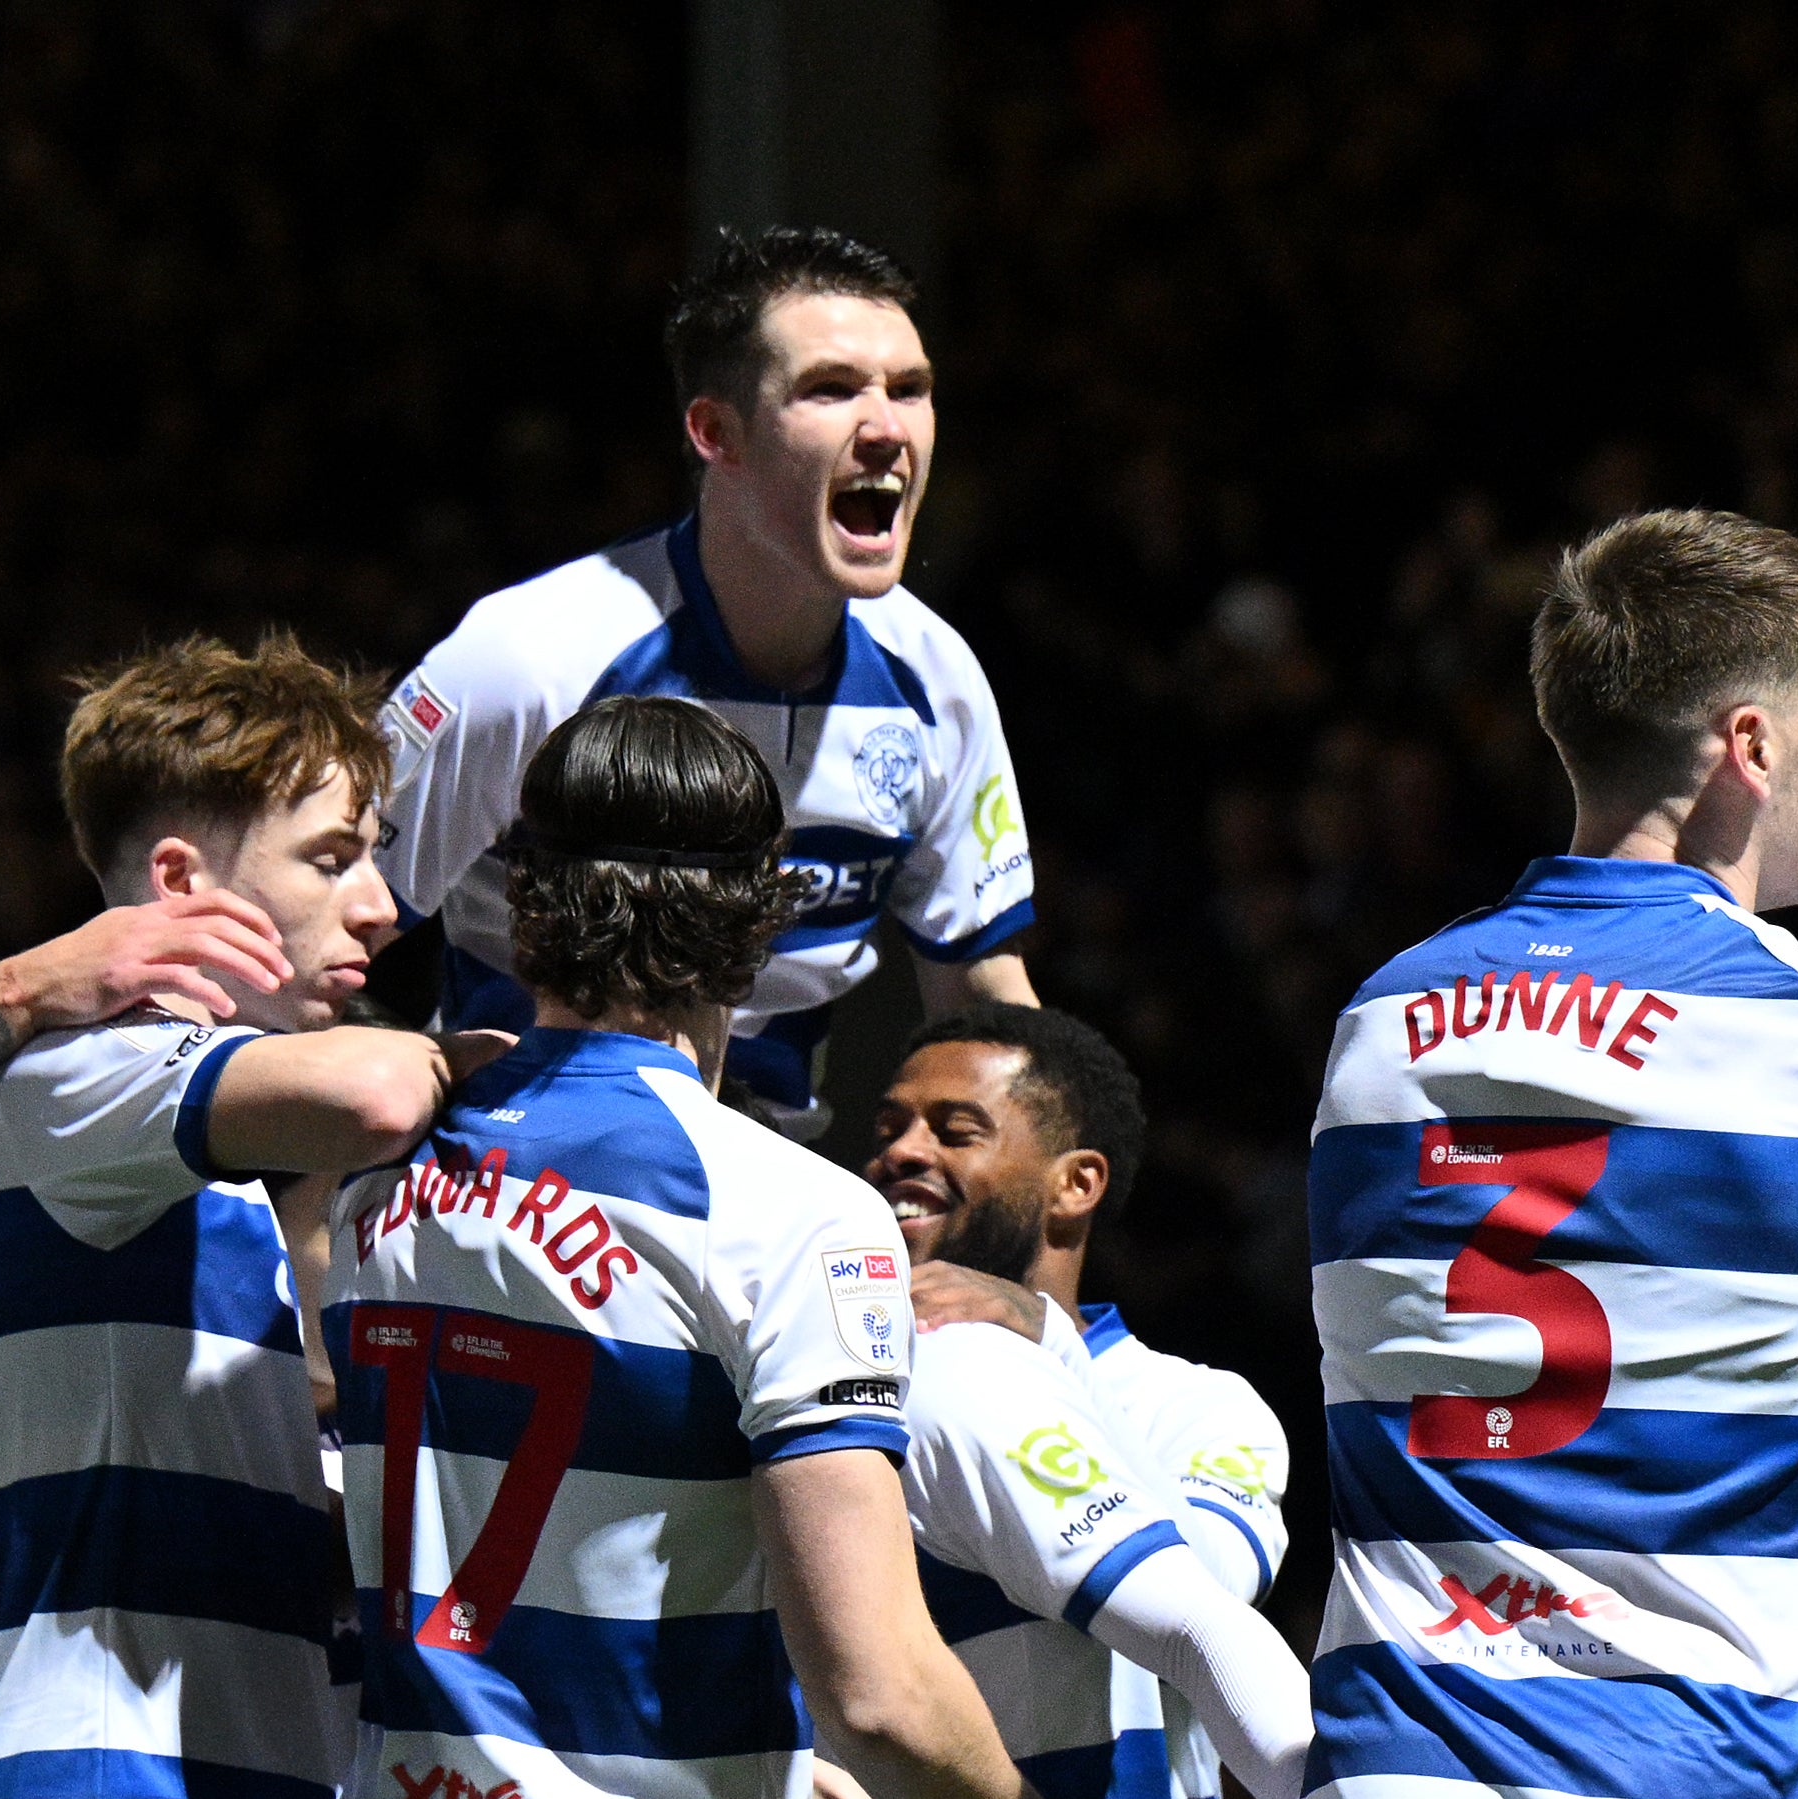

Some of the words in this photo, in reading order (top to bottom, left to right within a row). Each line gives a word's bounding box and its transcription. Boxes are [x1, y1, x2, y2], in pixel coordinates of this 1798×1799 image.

[1526, 943, 1574, 957] 1882
[1405, 970, 1678, 1071] DUNNE
[1447, 1154, 1503, 1164] COMMUNITY
[831, 1260, 862, 1279] sky
[867, 1257, 895, 1275] bet
[1406, 1124, 1612, 1459] 3
[465, 1345, 511, 1361] COMMUNITY
[871, 1344, 894, 1359] EFL
[1487, 1436, 1510, 1449] EFL
[351, 1305, 595, 1655] 17
[1059, 1490, 1129, 1547] MyGua
[1418, 1573, 1631, 1636] Xtra
[449, 1629, 472, 1642] EFL
[1436, 1641, 1614, 1657] AINTENANCE
